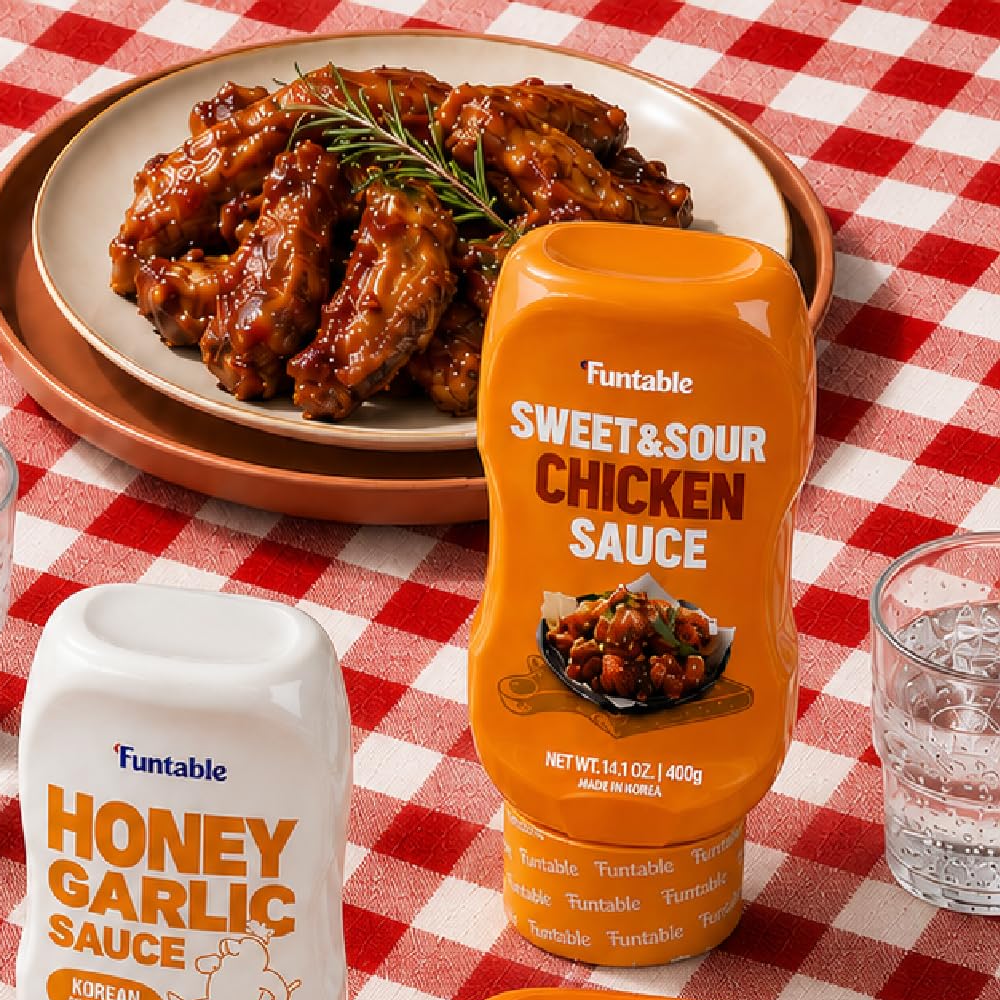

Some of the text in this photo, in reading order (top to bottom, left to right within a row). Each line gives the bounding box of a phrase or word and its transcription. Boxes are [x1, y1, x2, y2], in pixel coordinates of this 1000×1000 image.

[587, 360, 694, 394] Funtable
[510, 400, 767, 463] SWEET&SOUR
[535, 452, 745, 521] CHICKEN
[569, 517, 708, 569] SAUCE
[119, 745, 228, 782] Funtable
[545, 751, 574, 769] NET
[631, 763, 656, 780] OZ.
[665, 764, 703, 785] 400g
[577, 777, 662, 798] MADE IN KOREA
[47, 783, 299, 879] HONEY
[519, 847, 579, 876] Funtable
[594, 859, 674, 878] Funtable
[48, 858, 296, 937] GARLIC
[565, 892, 641, 914] Funtable
[48, 914, 186, 970] SAUCE
[528, 918, 592, 947] Funtable
[606, 925, 684, 947] Funtable
